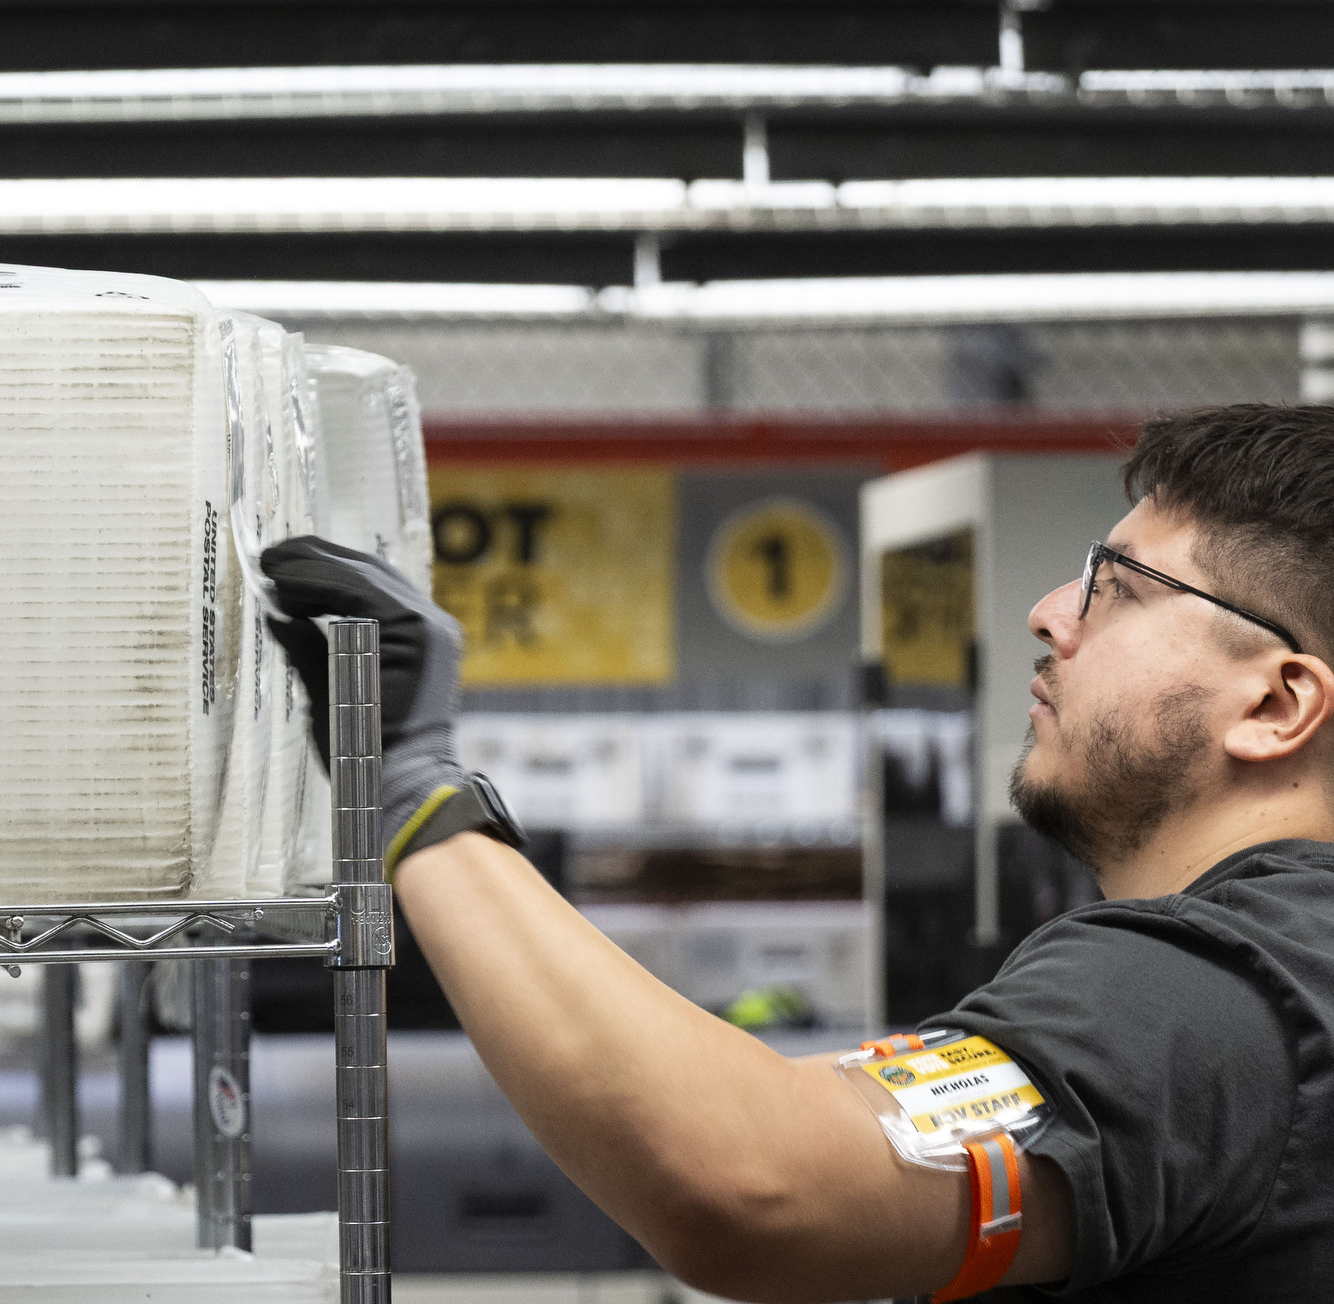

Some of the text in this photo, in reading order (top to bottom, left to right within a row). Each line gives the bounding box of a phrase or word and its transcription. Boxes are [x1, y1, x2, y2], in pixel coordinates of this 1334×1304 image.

[753, 533, 794, 606] 1
[201, 500, 212, 716] POSTAL SERVICE
[208, 510, 217, 704] UNITED STATES
[340, 1046, 355, 1058] 55
[930, 1075, 990, 1096] NICHOLAS
